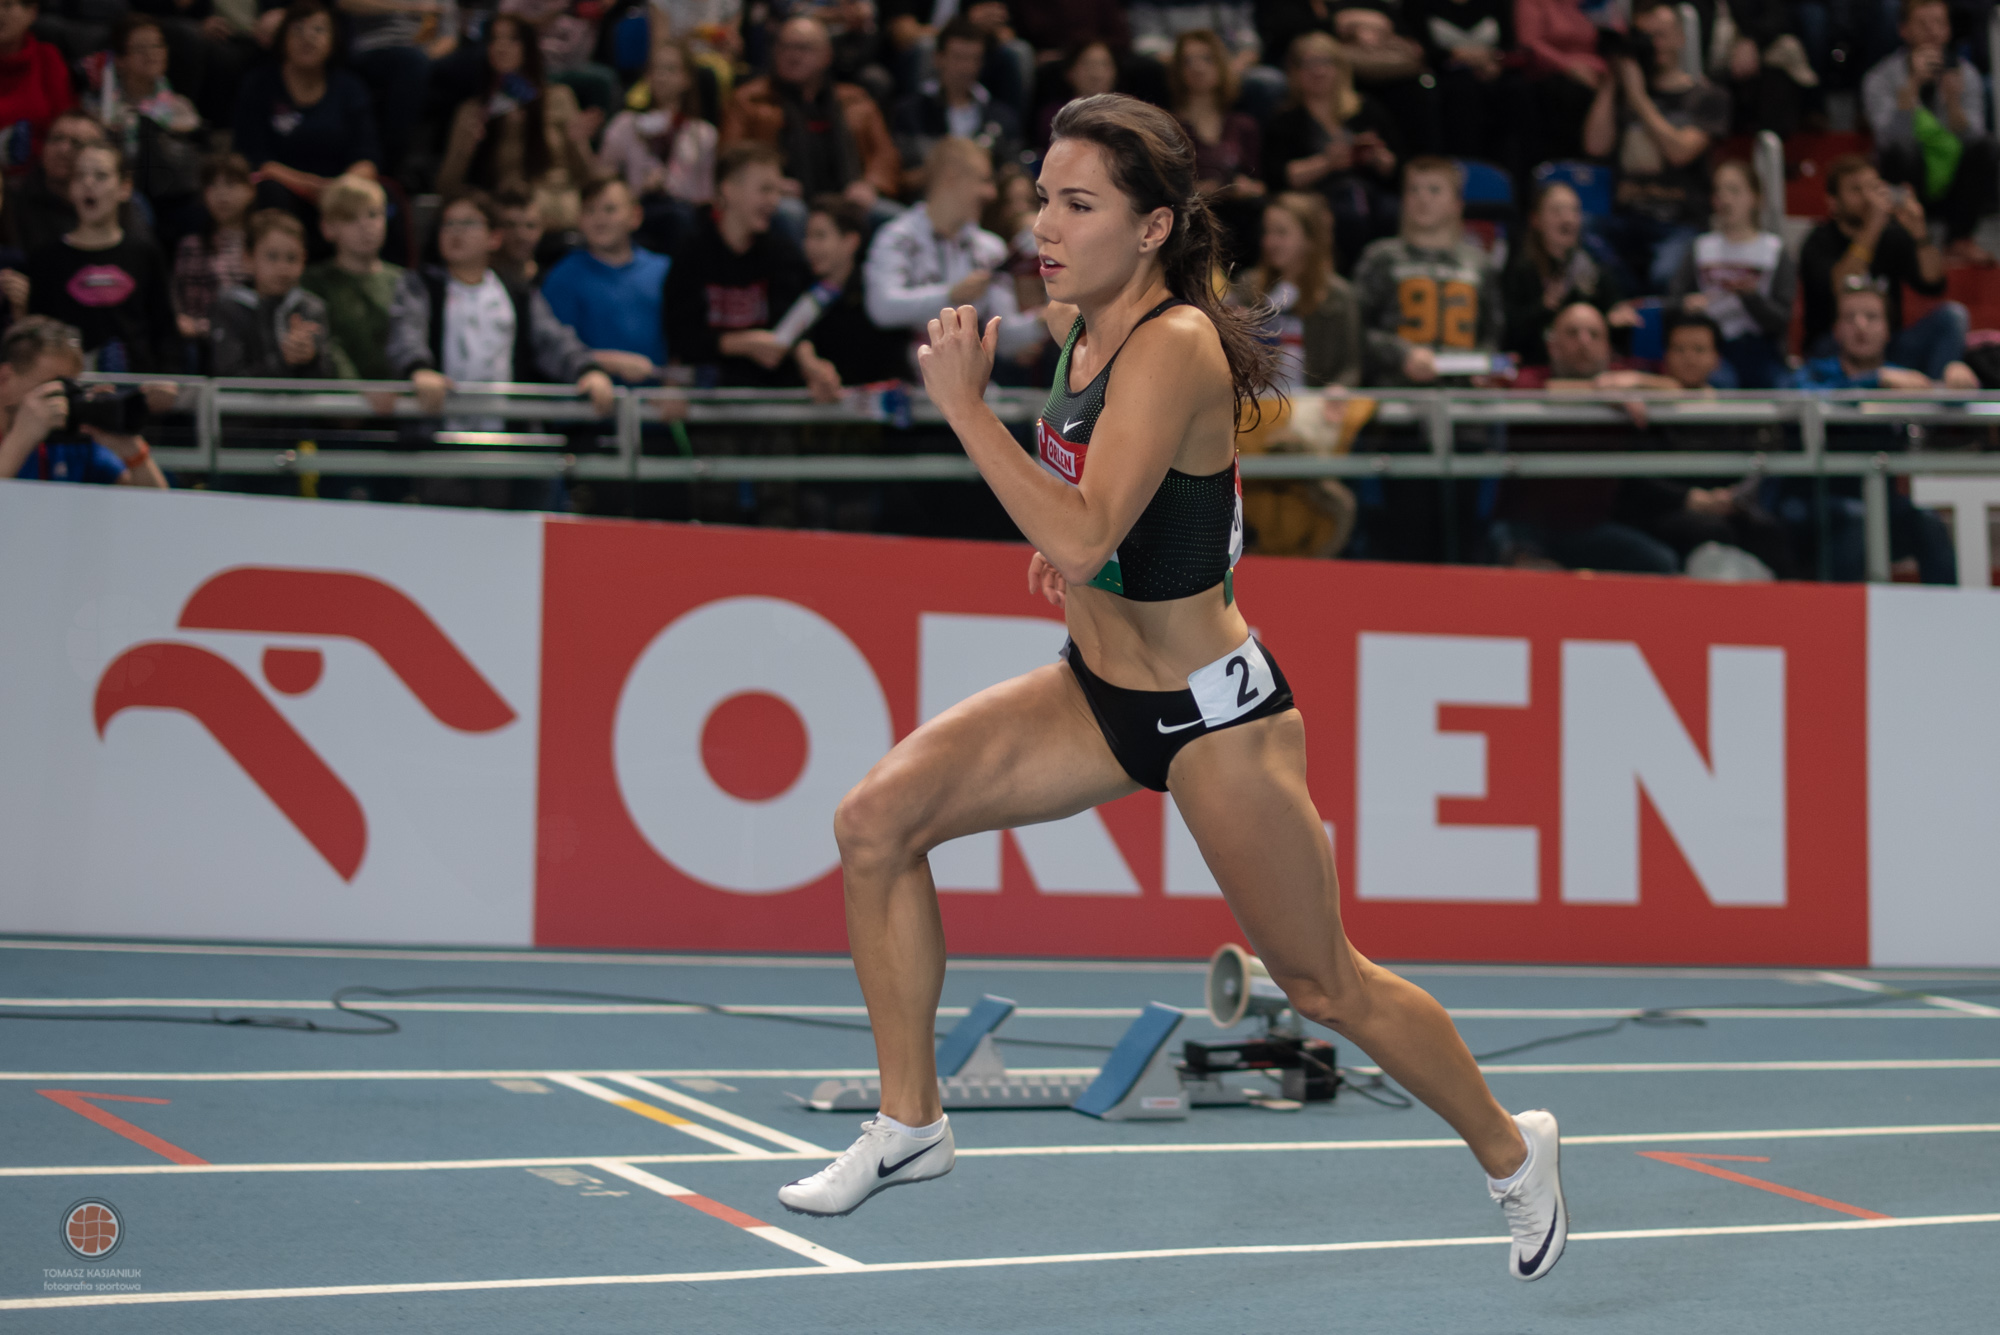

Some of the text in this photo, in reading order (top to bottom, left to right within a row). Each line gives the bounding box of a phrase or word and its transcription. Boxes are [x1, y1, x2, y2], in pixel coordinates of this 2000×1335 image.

[1397, 275, 1478, 349] 92
[1048, 440, 1073, 474] ORLEN
[1225, 655, 1260, 708] 2
[612, 595, 1787, 908] OEN
